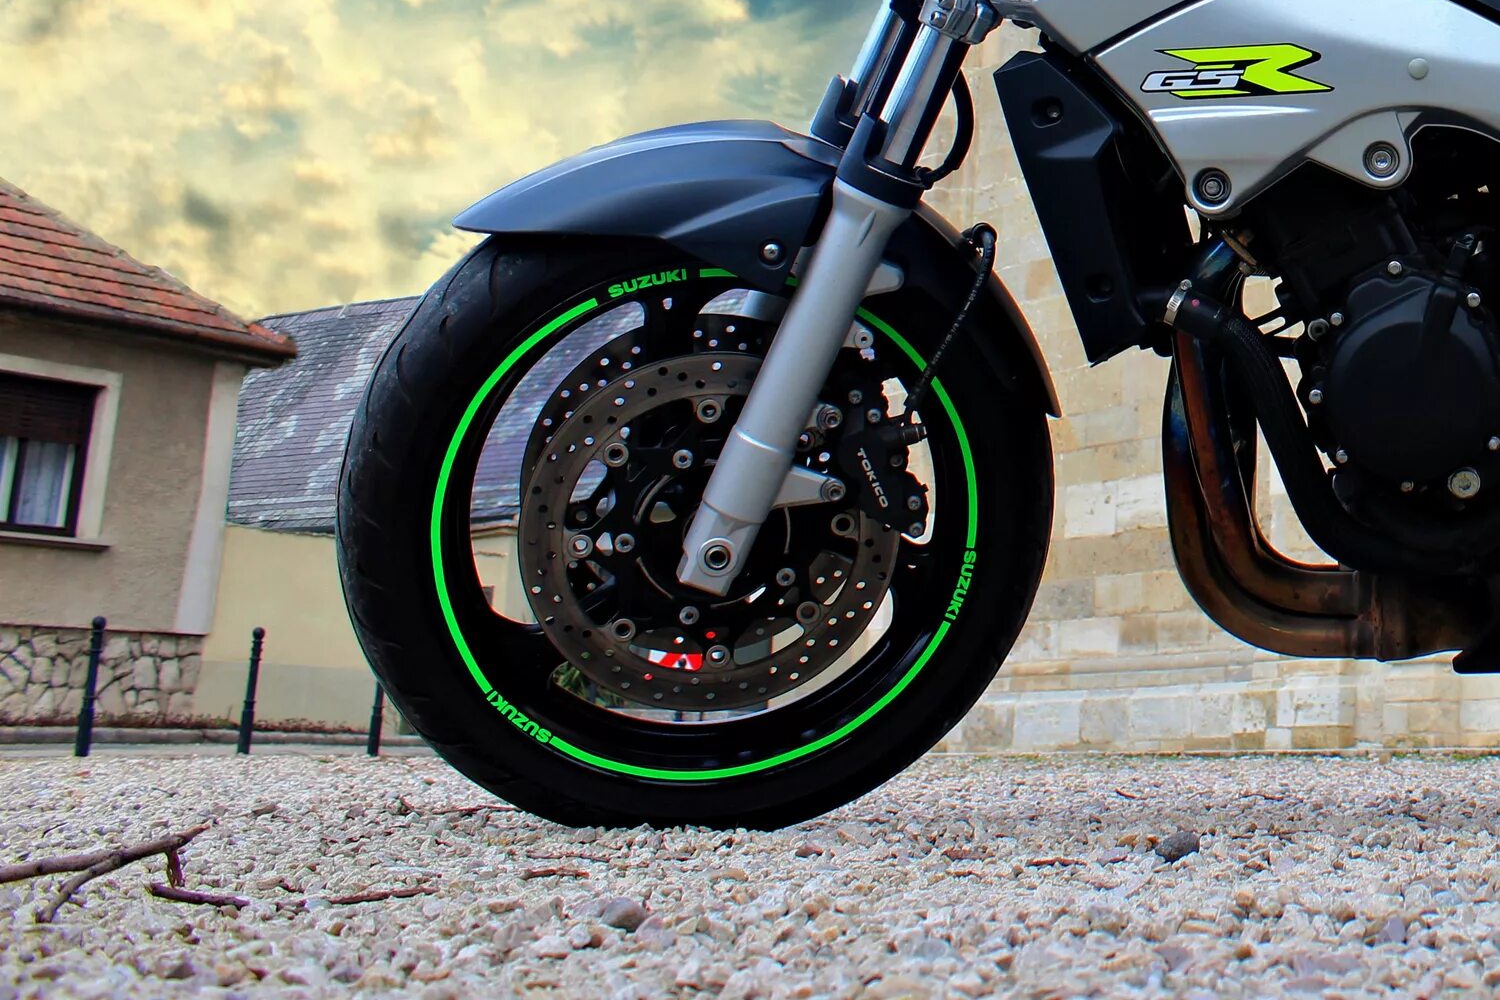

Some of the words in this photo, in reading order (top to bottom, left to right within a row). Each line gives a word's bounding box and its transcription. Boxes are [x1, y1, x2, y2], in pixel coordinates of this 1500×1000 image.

[1140, 42, 1334, 99] GSR
[608, 268, 688, 298] SUZUKI
[857, 447, 889, 508] TOKICO
[944, 551, 976, 622] SUZUKI
[486, 690, 552, 743] SUZUKI
